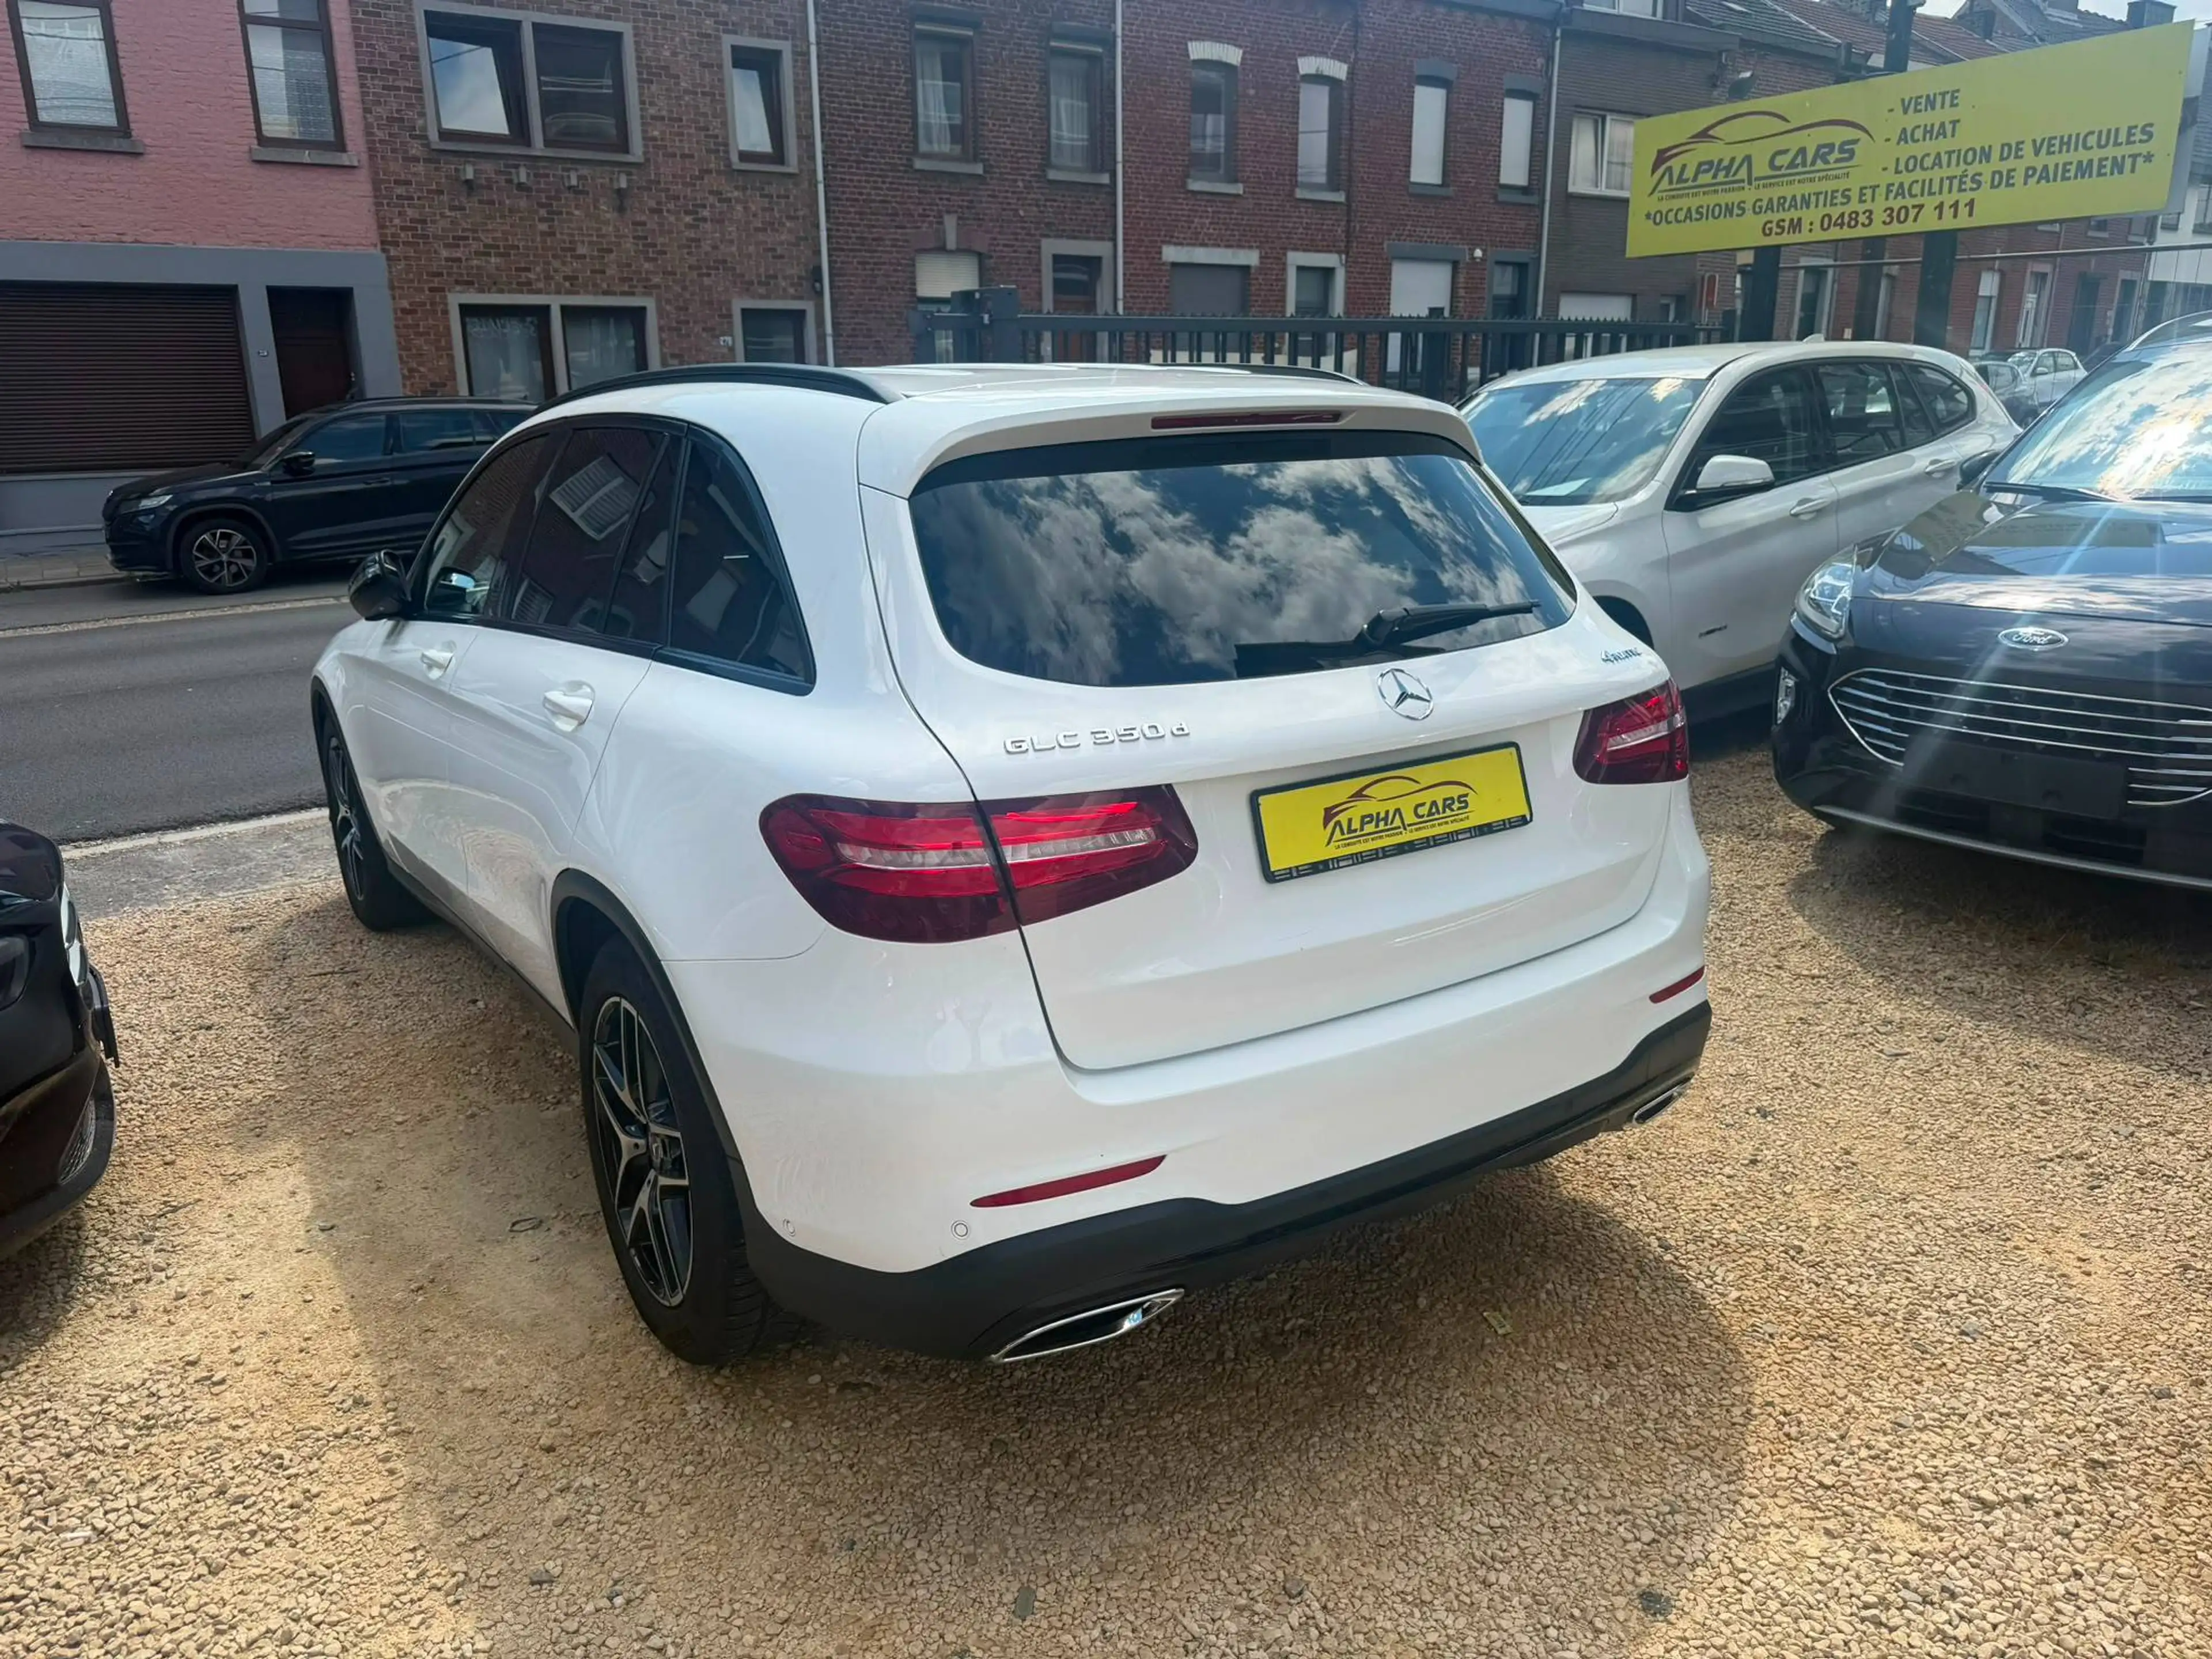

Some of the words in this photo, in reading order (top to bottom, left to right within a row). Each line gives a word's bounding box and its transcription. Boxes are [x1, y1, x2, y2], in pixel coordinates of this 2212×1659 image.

[1900, 88, 1960, 116] VENTE
[1893, 145, 1992, 175] LOCATION
[1998, 140, 2025, 162] DE
[2031, 122, 2154, 158] VEHICULES
[1896, 118, 1961, 146] ACHAT
[1647, 154, 1752, 197] ALPHA
[1767, 138, 1861, 172] CARS
[1752, 188, 1852, 215] GARANTIES
[1858, 184, 1880, 205] ET
[1884, 169, 1983, 202] FACILITÉS
[1990, 168, 2017, 190] DE
[1761, 216, 1802, 238] GSM
[1819, 209, 1874, 233] 0483
[1881, 204, 1925, 226] 307
[1933, 198, 1976, 221] 111
[2012, 630, 2053, 645] Ford
[1003, 731, 1081, 755] GLC
[1090, 721, 1166, 745] 350
[1171, 721, 1190, 737] d
[1325, 807, 1407, 847] ALPHA
[1413, 792, 1469, 820] CARS
